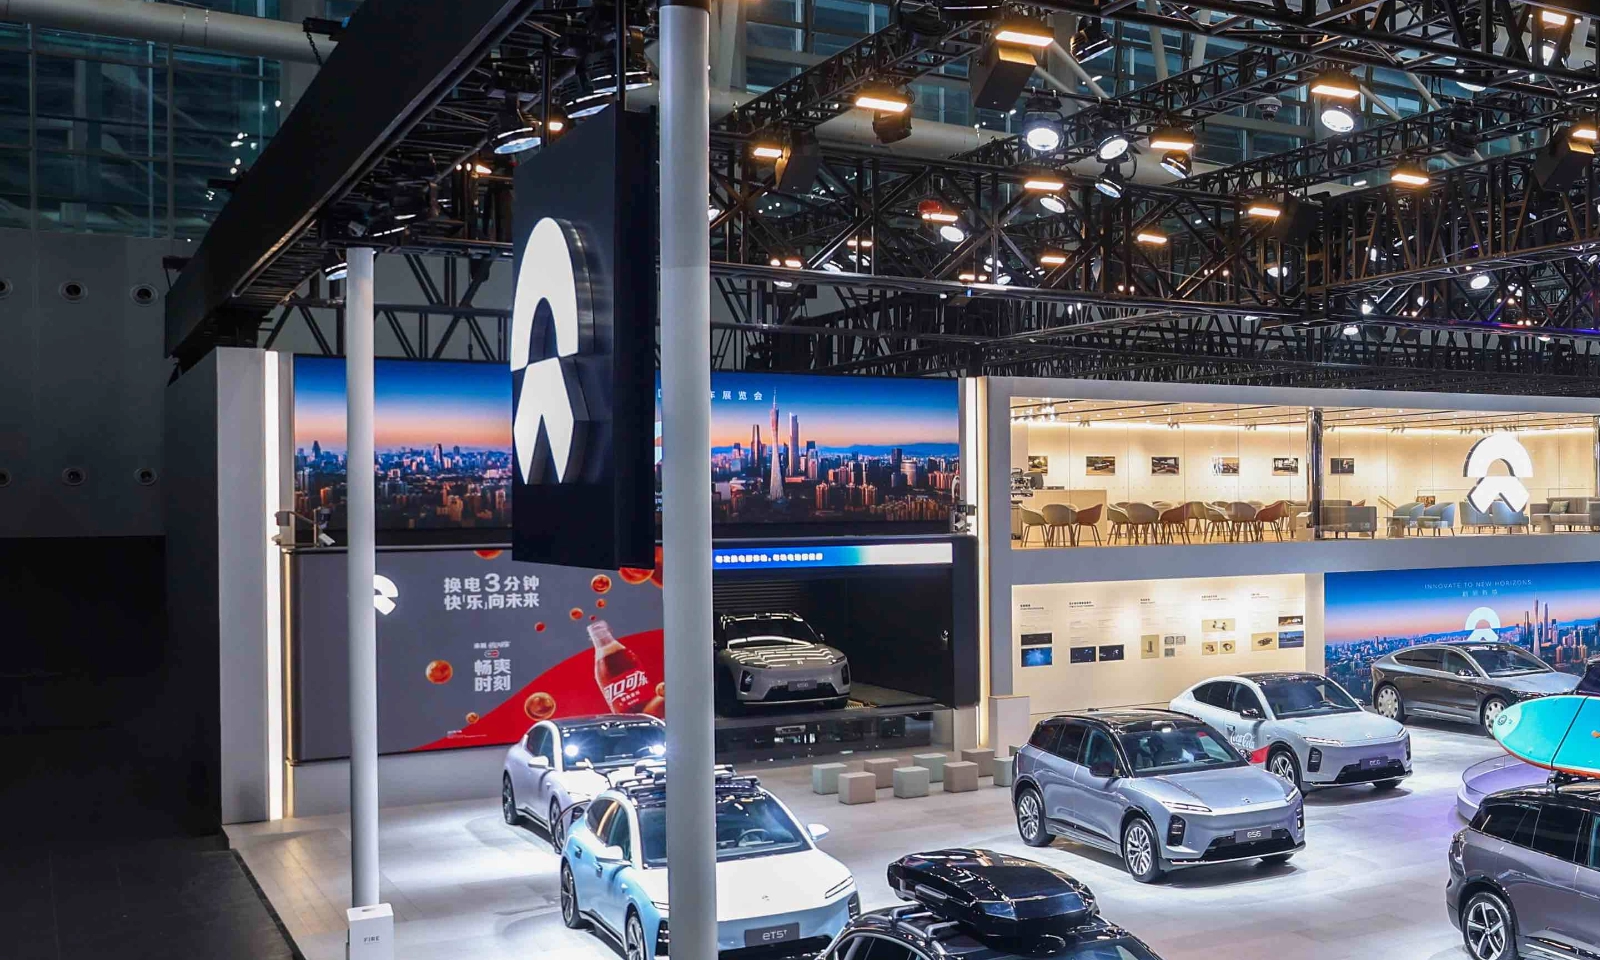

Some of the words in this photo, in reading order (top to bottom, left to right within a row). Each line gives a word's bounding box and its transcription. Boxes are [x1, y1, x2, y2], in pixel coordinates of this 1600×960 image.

[443, 573, 540, 594] 换电3分钟
[474, 658, 511, 676] 畅爽
[474, 675, 511, 692] 时刻
